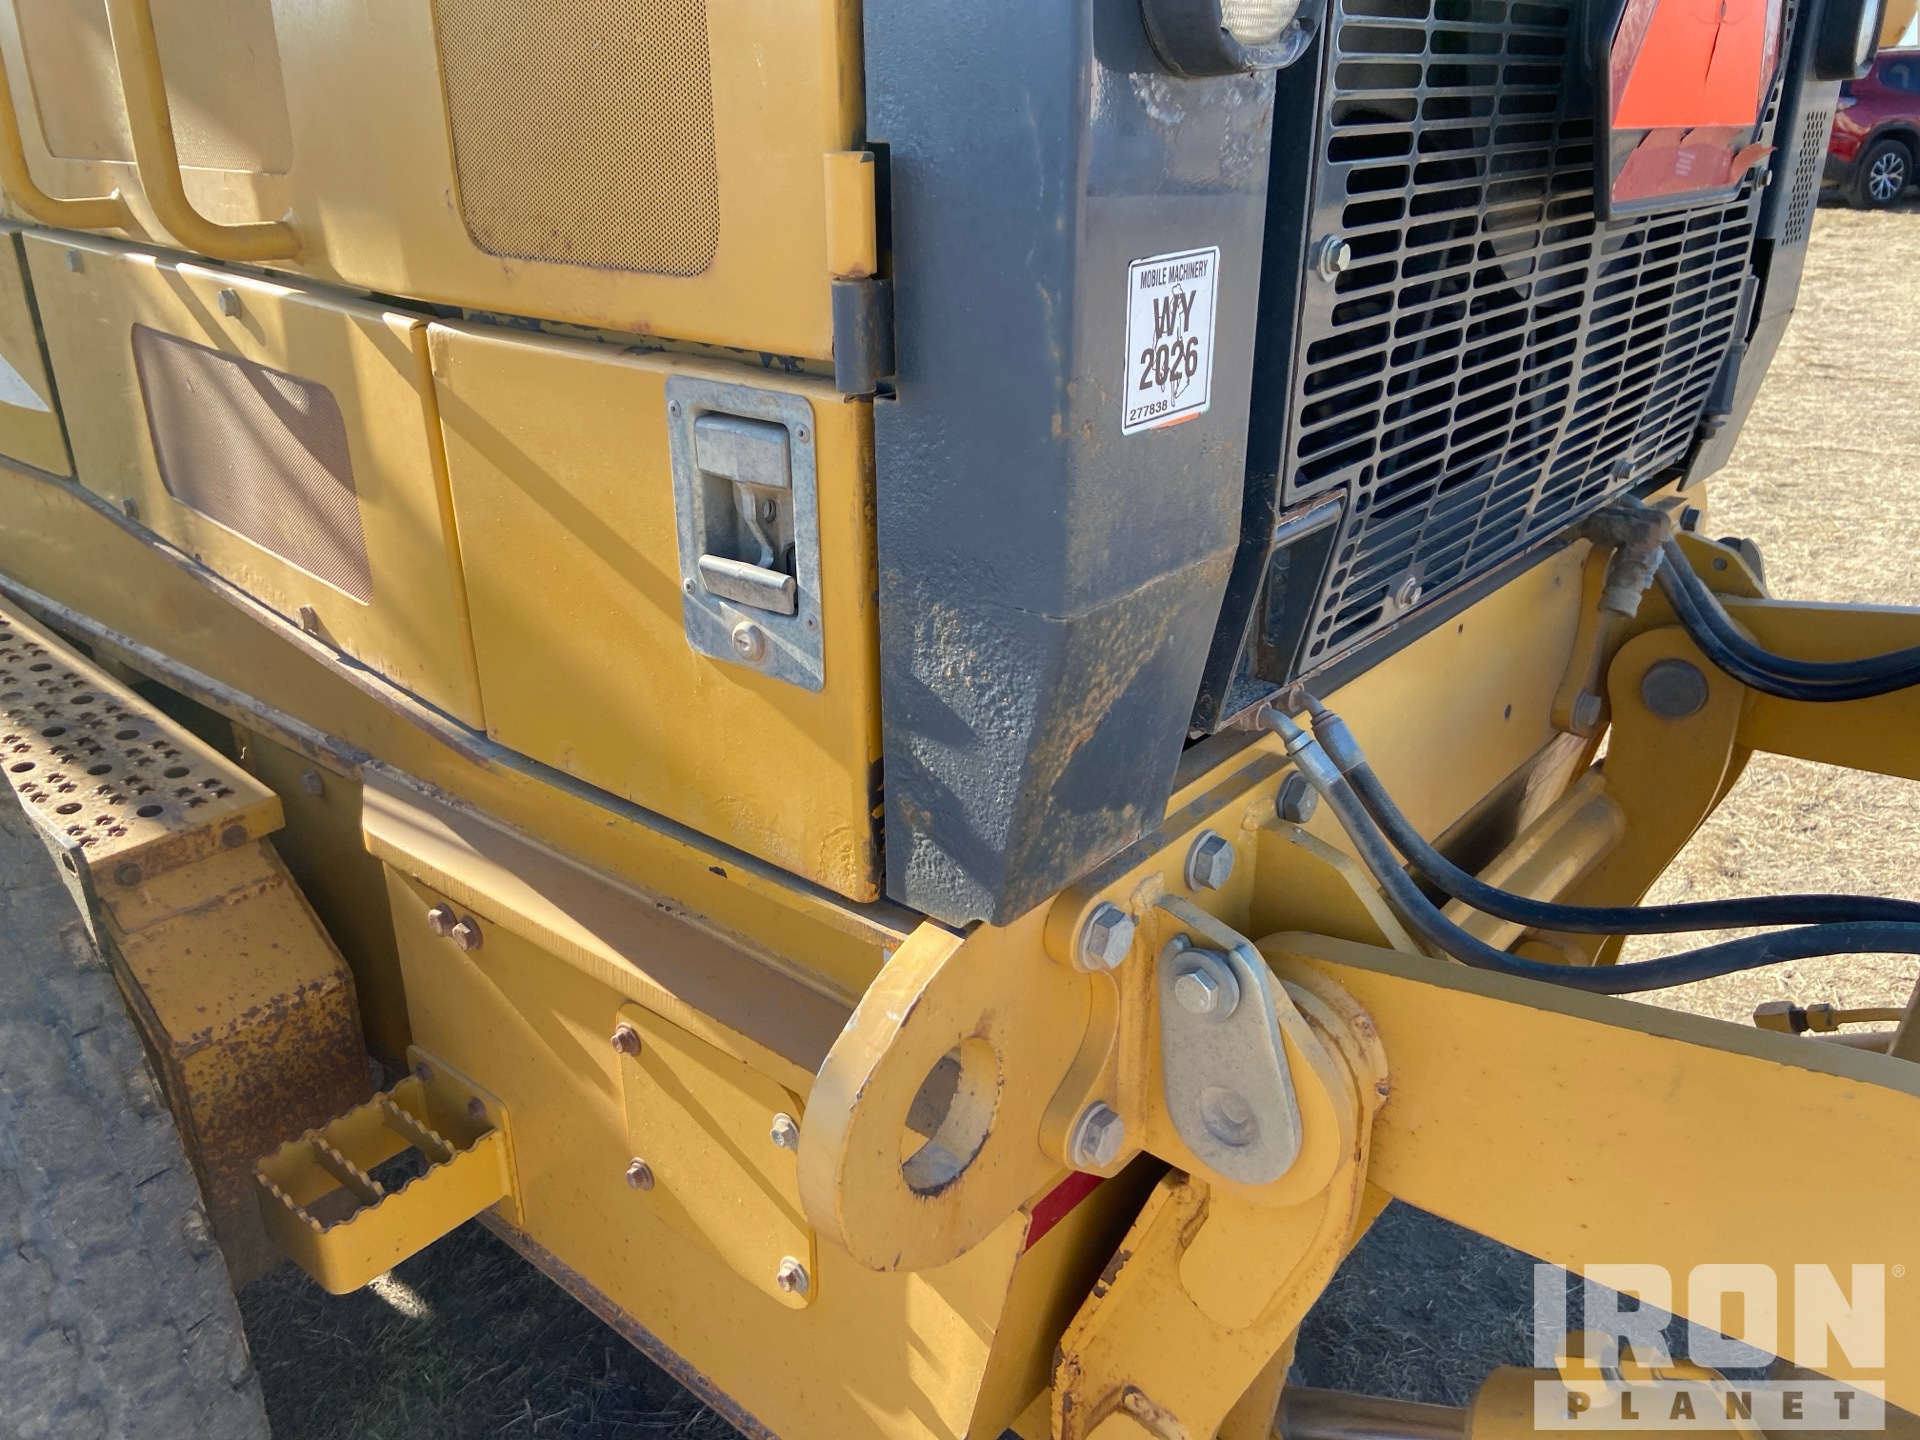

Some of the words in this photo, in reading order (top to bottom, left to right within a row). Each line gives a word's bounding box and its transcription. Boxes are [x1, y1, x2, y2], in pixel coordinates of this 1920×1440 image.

[1140, 267, 1167, 290] MOBILE
[1168, 259, 1208, 284] MACHINERY
[1153, 290, 1197, 338] WY
[1139, 336, 1199, 391] 2026
[1129, 399, 1168, 421] 277838
